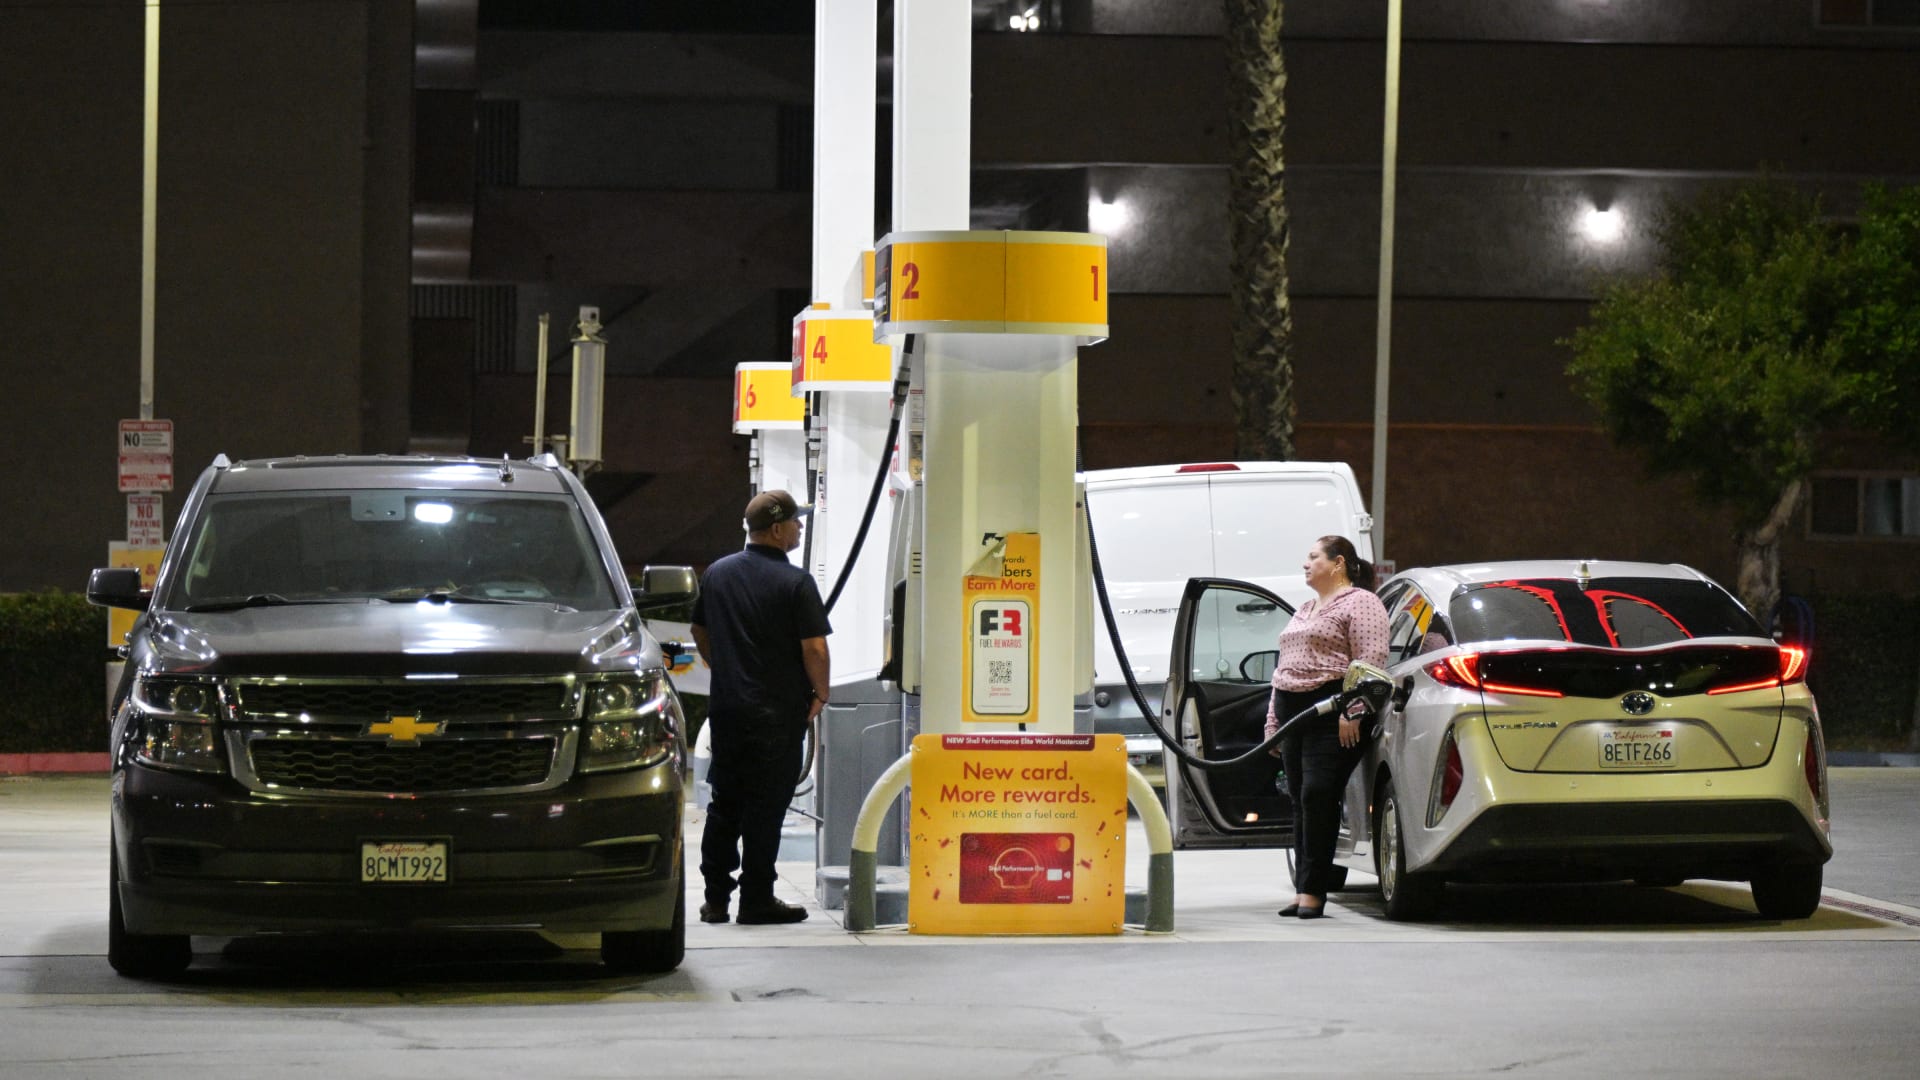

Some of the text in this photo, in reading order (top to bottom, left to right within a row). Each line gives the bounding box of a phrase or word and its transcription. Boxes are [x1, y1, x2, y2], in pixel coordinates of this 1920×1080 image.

[902, 262, 919, 300] 2
[1091, 265, 1099, 301] 1
[813, 336, 828, 364] 4
[746, 384, 757, 409] 6
[124, 432, 140, 447] NO
[137, 505, 153, 518] NO
[130, 520, 160, 528] PARKING
[1002, 564, 1032, 577] bers
[967, 578, 1036, 590] Earn More
[979, 639, 1022, 648] FUEL REWARDS
[965, 737, 980, 745] Shell
[982, 737, 1019, 745] Performance
[1604, 742, 1672, 761] 8ETF266
[963, 760, 1074, 780] New card.
[940, 783, 1096, 804] More rewards.
[968, 810, 999, 819] MORE
[1001, 810, 1022, 819] than
[1034, 809, 1052, 819] fuel
[1054, 810, 1078, 819] card.
[366, 856, 443, 877] 8CMT992
